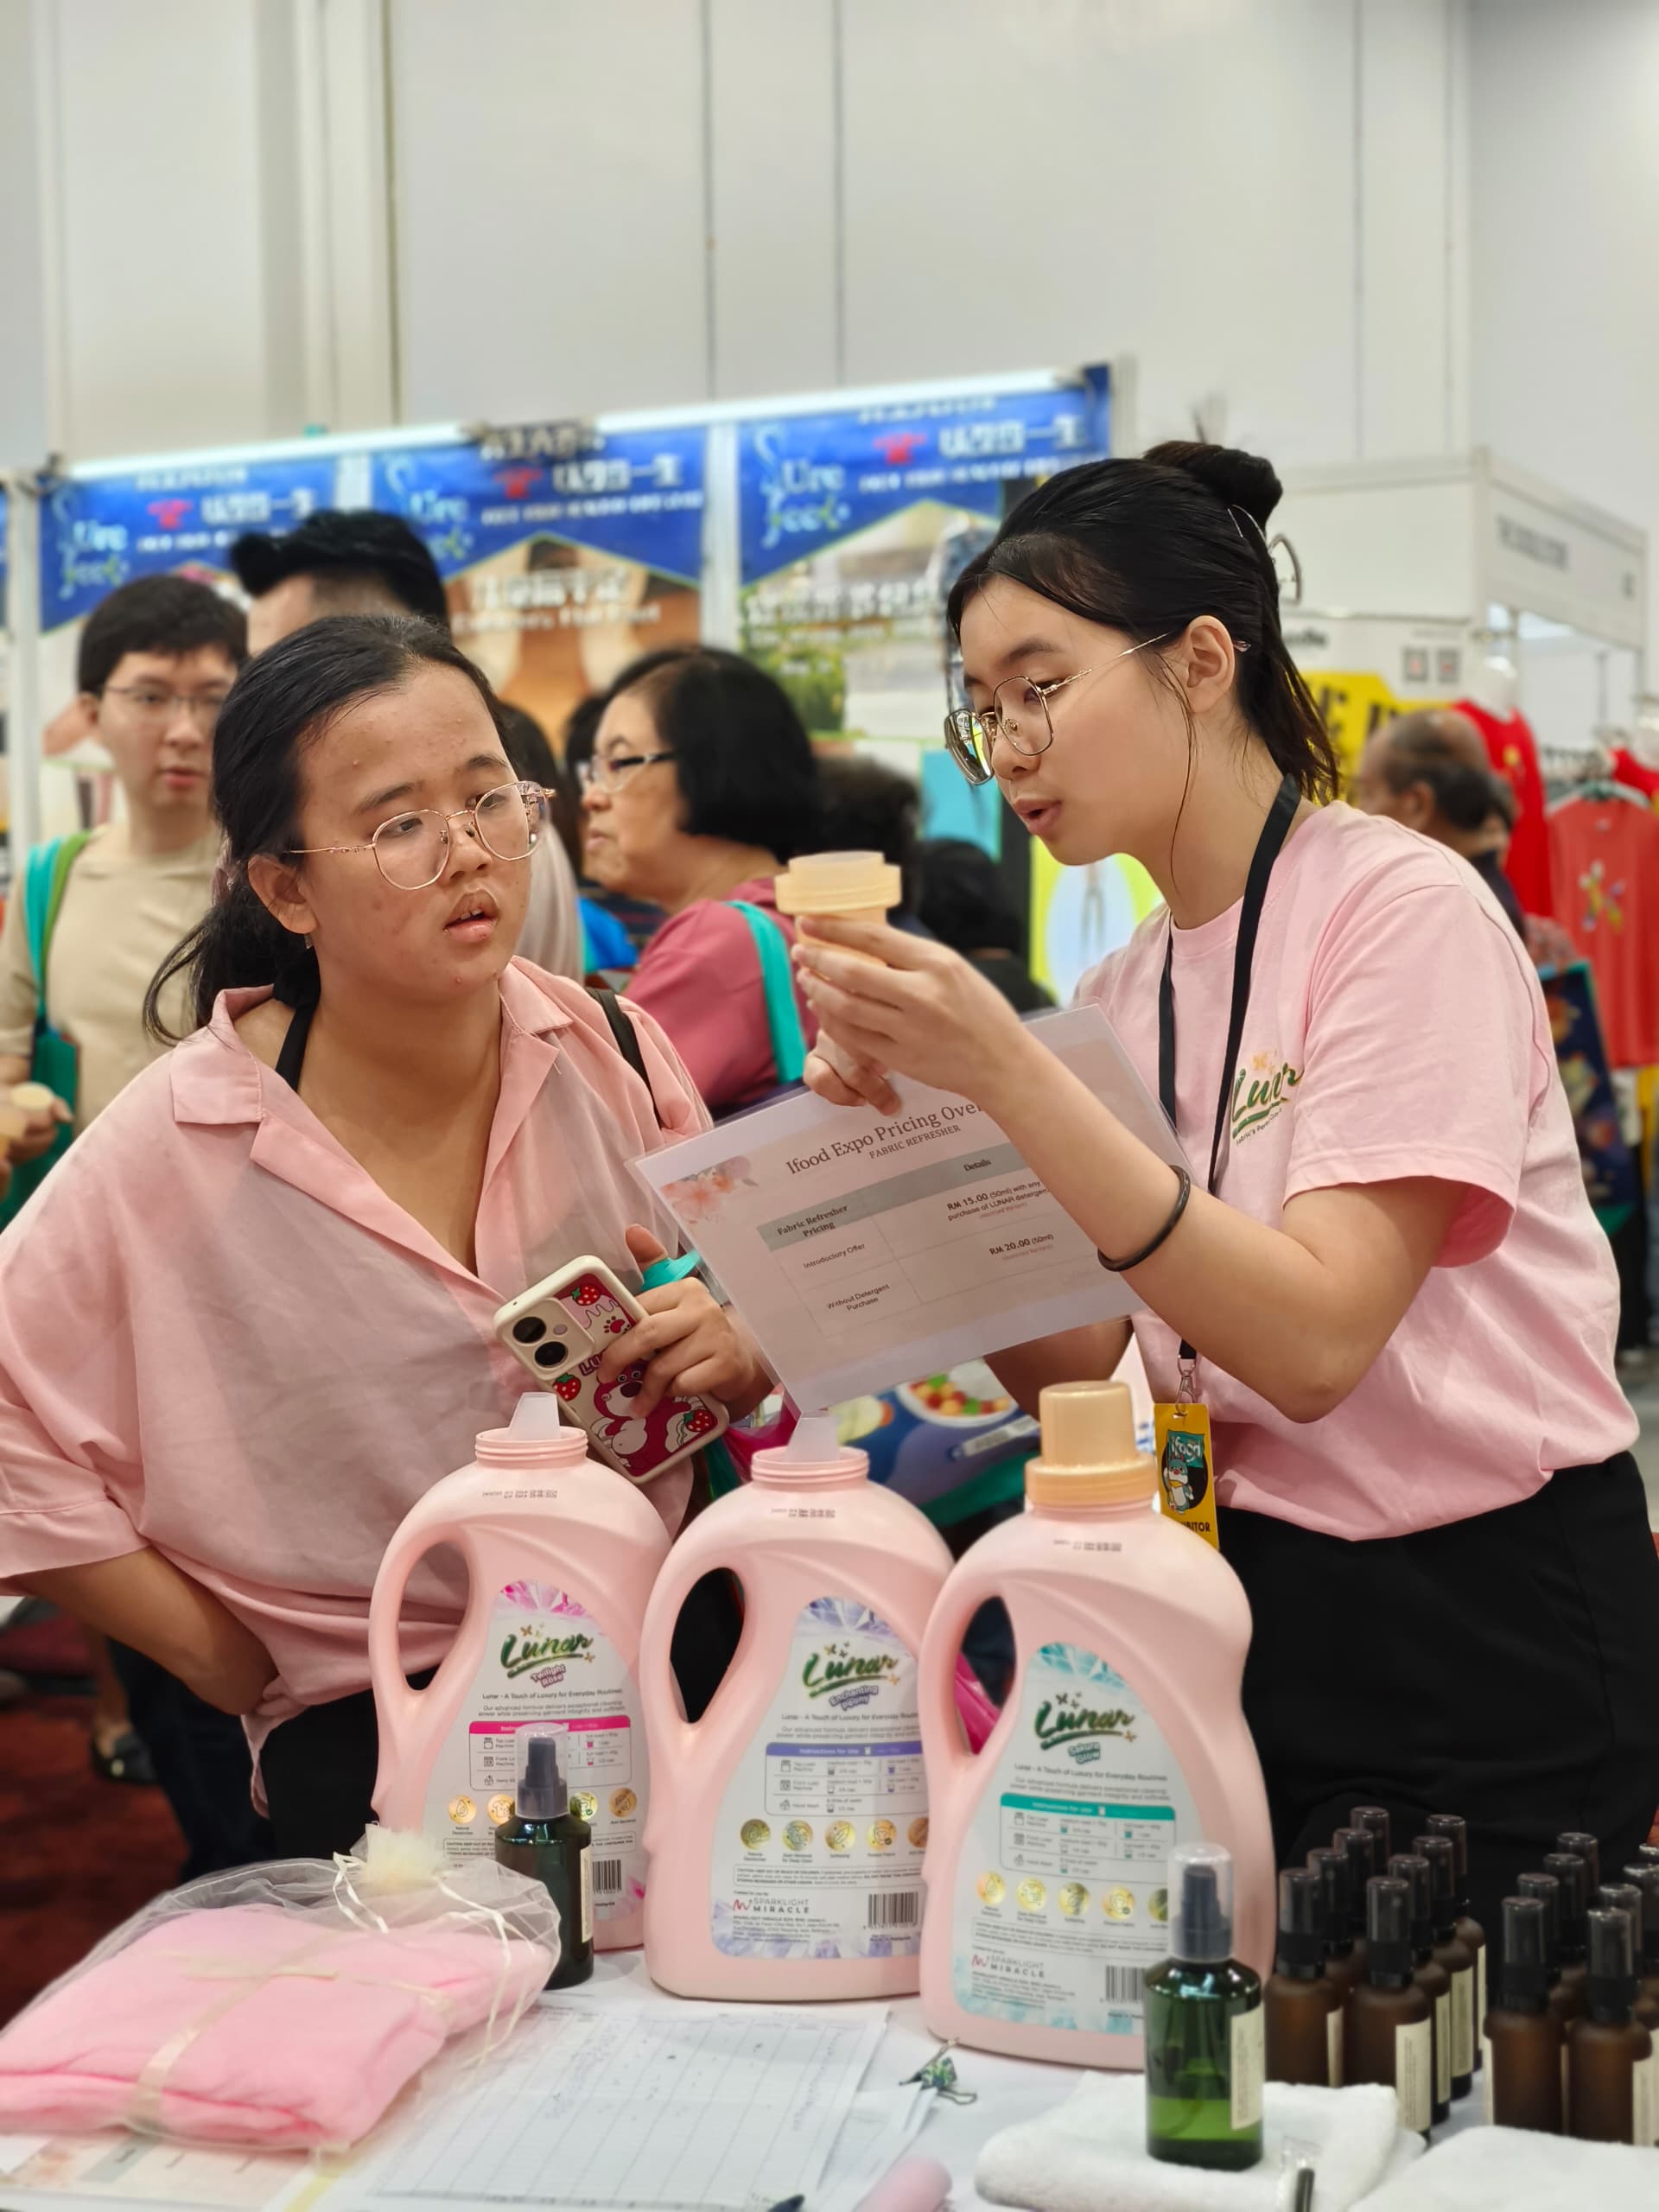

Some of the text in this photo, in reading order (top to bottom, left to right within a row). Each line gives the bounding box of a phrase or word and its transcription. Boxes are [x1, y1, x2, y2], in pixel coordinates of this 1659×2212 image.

[786, 1147, 830, 1174] Ifood
[831, 1133, 874, 1157] Expo
[874, 1113, 941, 1141] Pricing
[869, 1124, 961, 1159] FABRIC REFRESHER
[963, 1159, 992, 1172] Details
[947, 1202, 962, 1211] RM
[963, 1193, 988, 1205] 15.00
[948, 1207, 980, 1221] purchase
[990, 1197, 1014, 1208] LUNAR
[777, 1205, 849, 1236] Fabric Refresher
[802, 1221, 836, 1237] Pricing
[989, 1247, 1004, 1255] RM
[1004, 1238, 1030, 1251] 20.00
[804, 1243, 865, 1269] Introductory Offer
[827, 1283, 890, 1309] Without Detergent
[846, 1296, 879, 1311] Purchase
[500, 1633, 594, 1669] Lunar
[531, 1664, 566, 1682] Twilight
[803, 1652, 899, 1688] Lunar
[537, 1691, 557, 1700] Luxury
[830, 1685, 879, 1707] Enchanting
[1034, 1700, 1135, 1738] Lunar
[1068, 1742, 1100, 1757] Sakura
[1076, 1750, 1101, 1764] Glow
[1071, 1769, 1092, 1777] Luxury
[1106, 1772, 1136, 1781] Everyday
[753, 1897, 810, 1906] SPARKLIGHT
[753, 1905, 810, 1914] MIRACLE
[991, 1955, 1044, 1968] SPARKLIGHT
[991, 1964, 1045, 1978] MIRACLE
